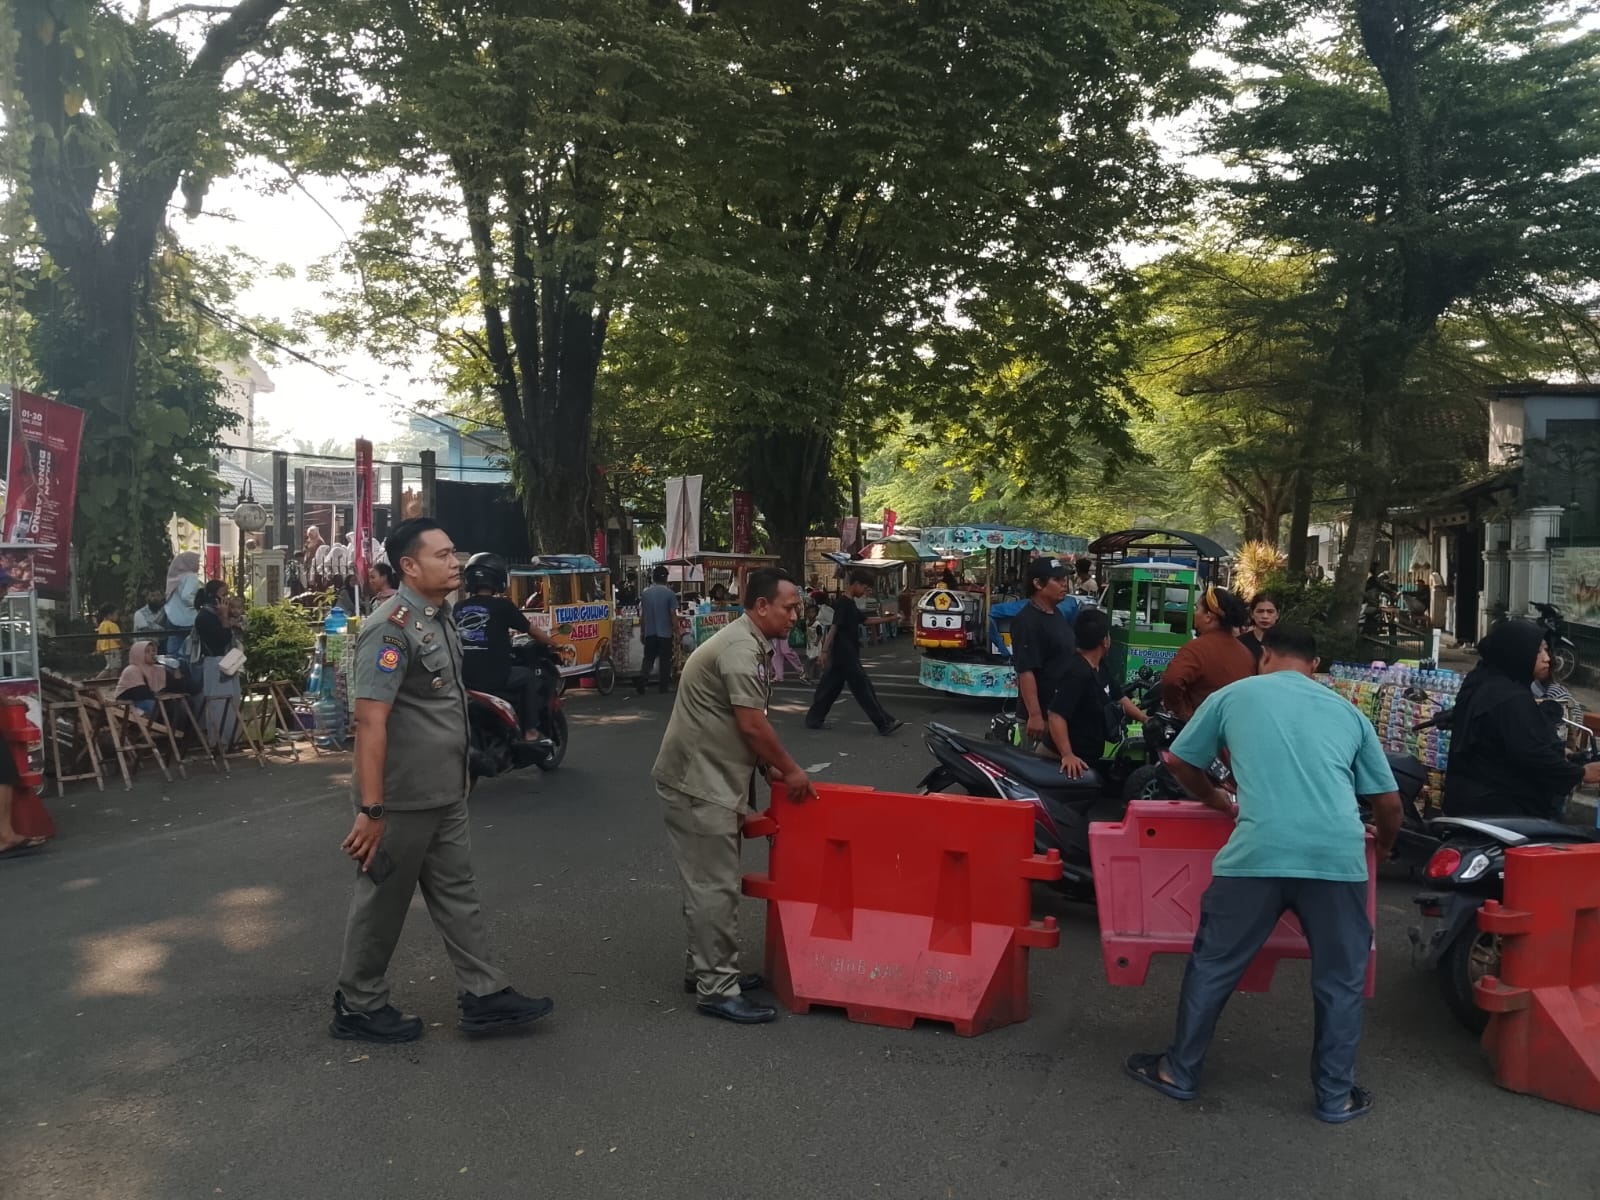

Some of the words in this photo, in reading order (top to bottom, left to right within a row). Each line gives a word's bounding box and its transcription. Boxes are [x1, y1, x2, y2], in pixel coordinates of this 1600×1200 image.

[38, 449, 46, 486] BUNG
[555, 606, 580, 624] TELUR
[580, 604, 610, 621] GULUNG
[570, 623, 599, 640] ABLEH
[1155, 650, 1178, 659] GULUN
